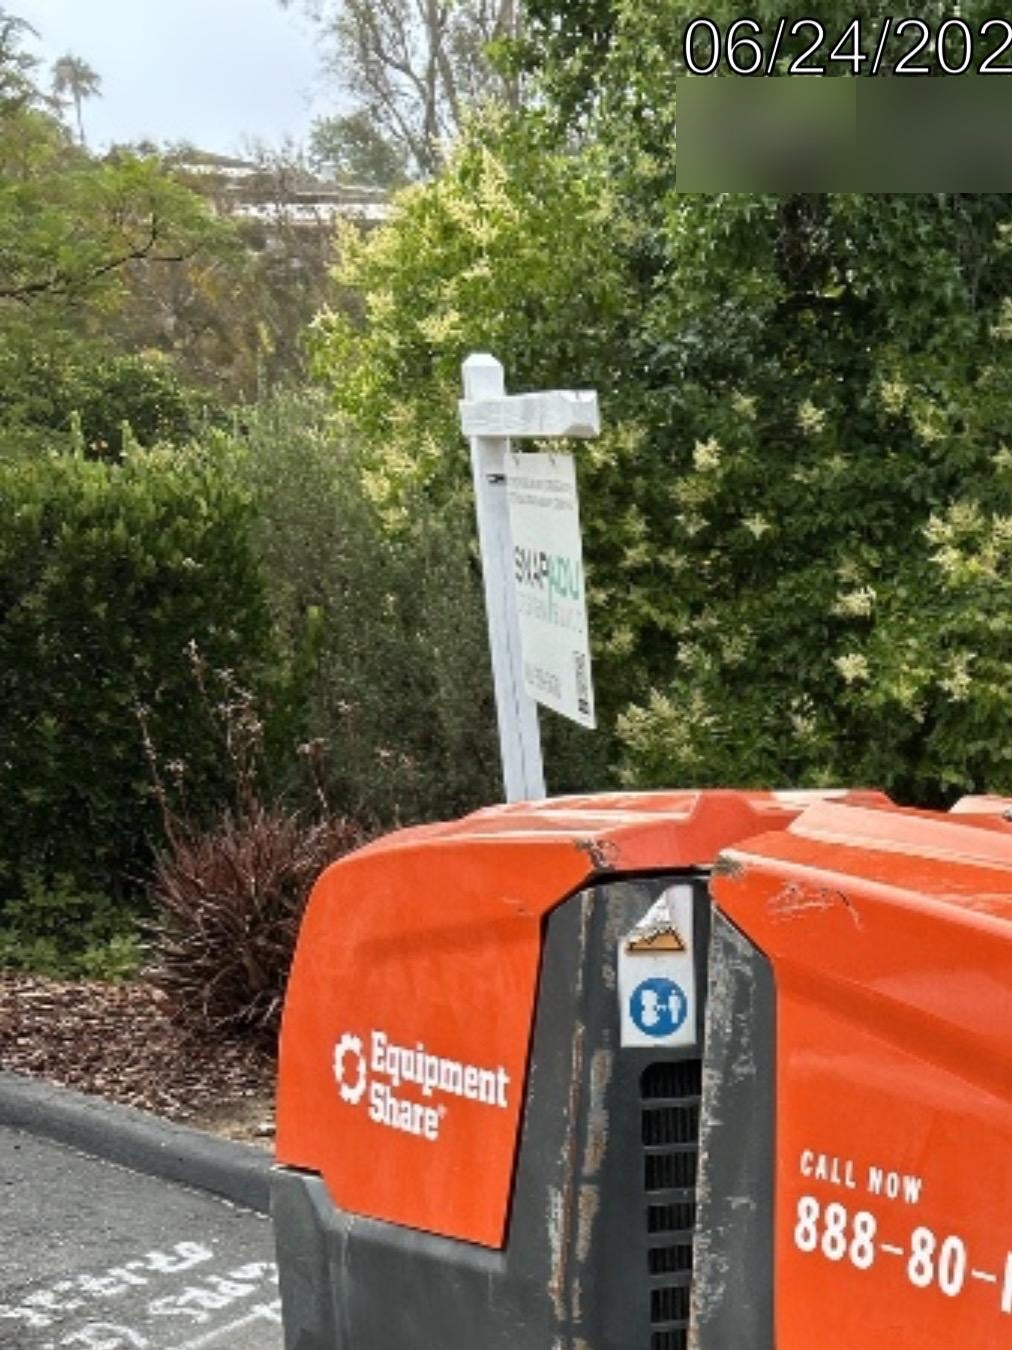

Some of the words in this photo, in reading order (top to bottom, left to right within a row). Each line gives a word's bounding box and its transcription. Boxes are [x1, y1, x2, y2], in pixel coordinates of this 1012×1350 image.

[370, 1029, 510, 1109] Equipment
[799, 1149, 857, 1189] CALL
[867, 1165, 924, 1204] NOW
